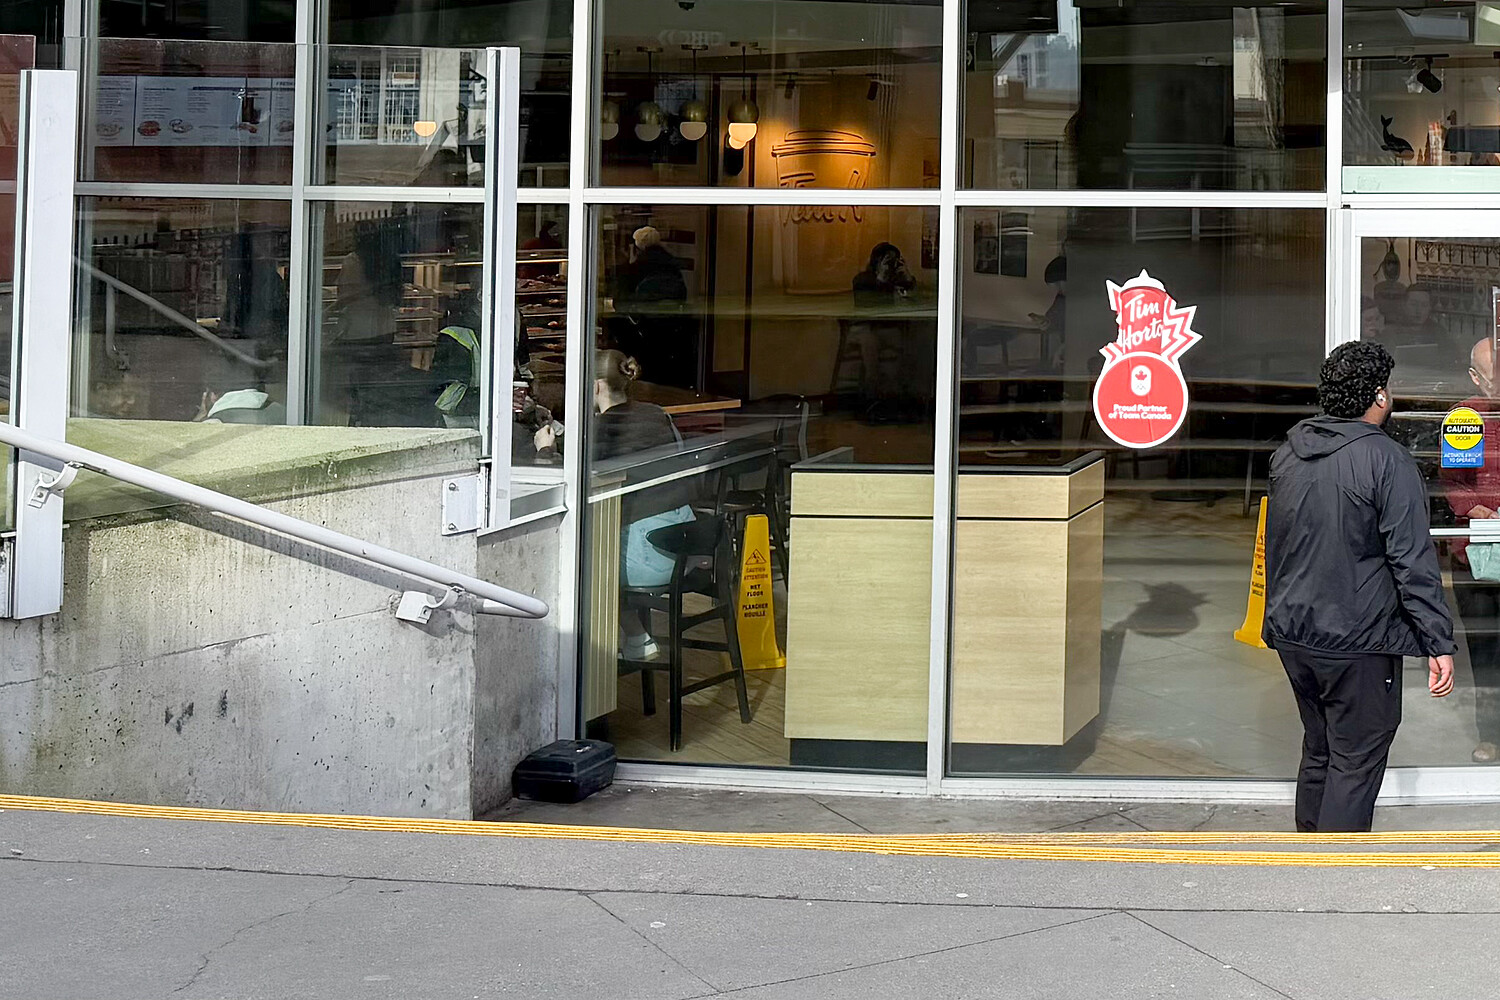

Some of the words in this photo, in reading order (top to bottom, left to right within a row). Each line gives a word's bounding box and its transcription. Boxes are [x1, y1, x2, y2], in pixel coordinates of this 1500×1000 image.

[1124, 293, 1161, 323] Tim
[1113, 403, 1137, 412] Proud
[1138, 404, 1168, 412] Partner
[1108, 411, 1118, 419] of
[1118, 411, 1141, 419] Team
[1141, 411, 1172, 420] Canada
[1446, 425, 1481, 433] CAUTION
